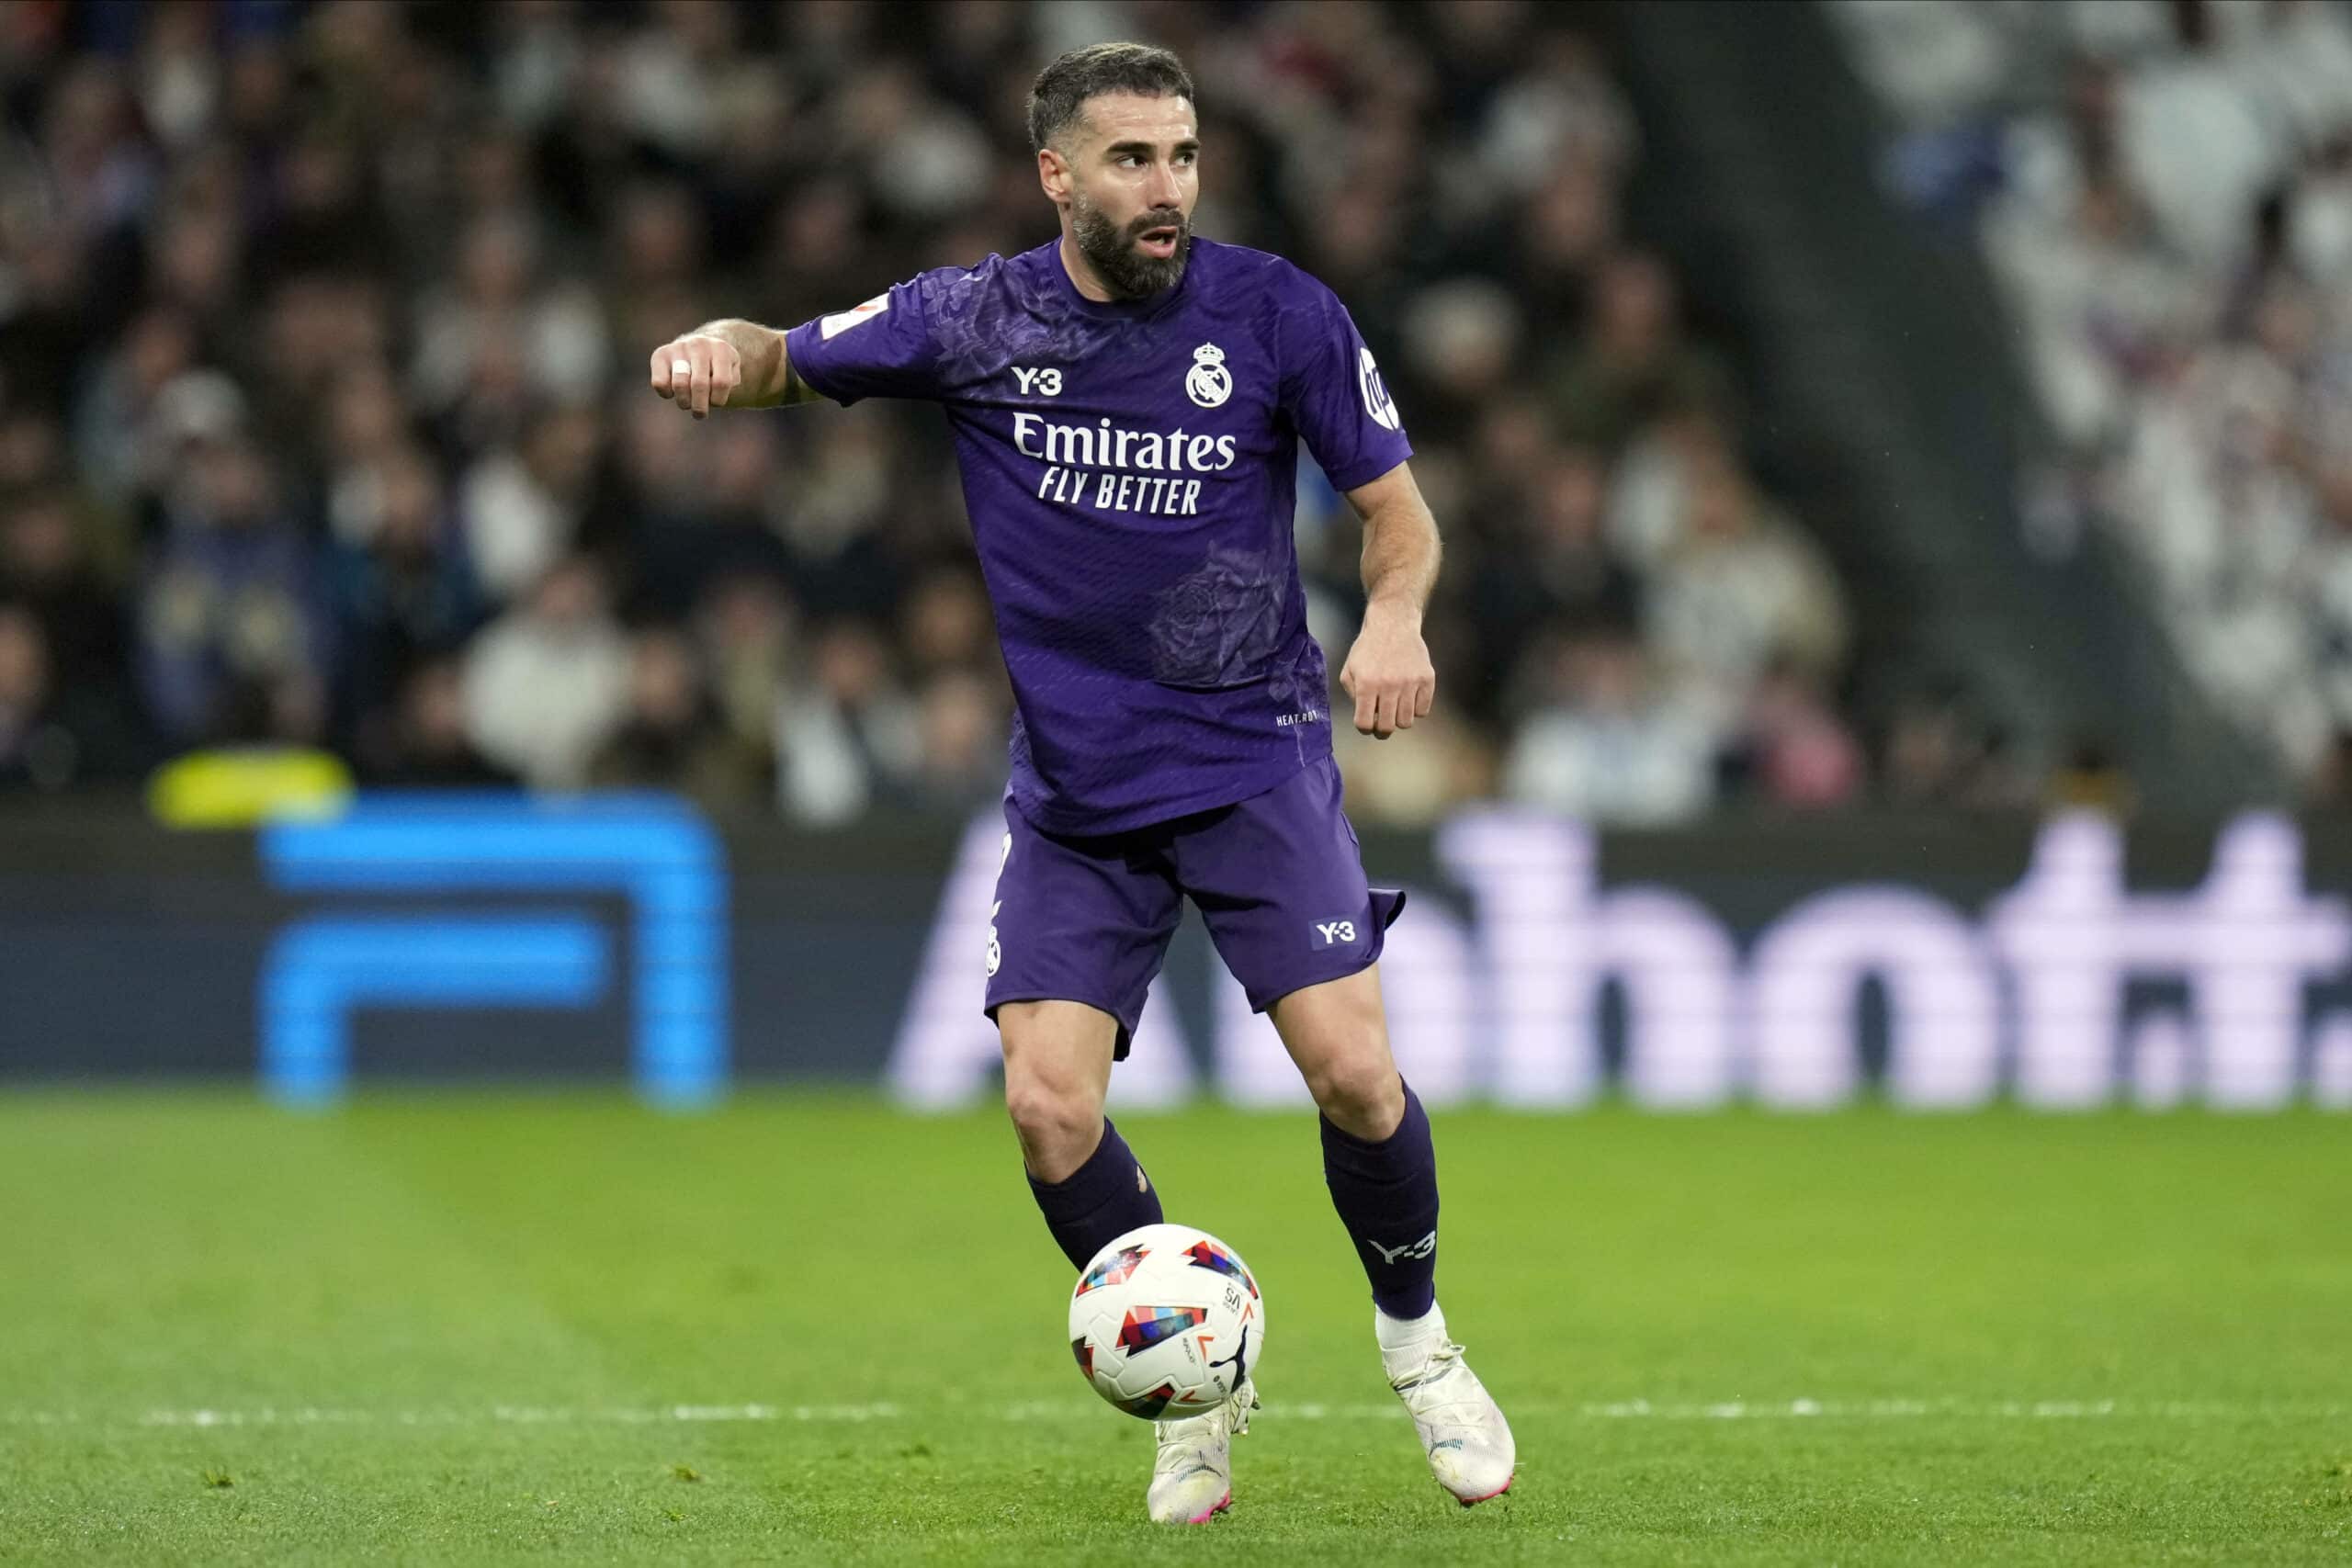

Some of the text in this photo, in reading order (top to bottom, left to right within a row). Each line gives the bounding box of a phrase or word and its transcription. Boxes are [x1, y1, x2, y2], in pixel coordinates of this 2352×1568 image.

[1011, 367, 1063, 397] Y-3
[1012, 412, 1237, 472] Emirates
[1038, 466, 1202, 515] FLY BETTER
[1316, 920, 1357, 944] Y-3
[1366, 1230, 1436, 1265] Y-3
